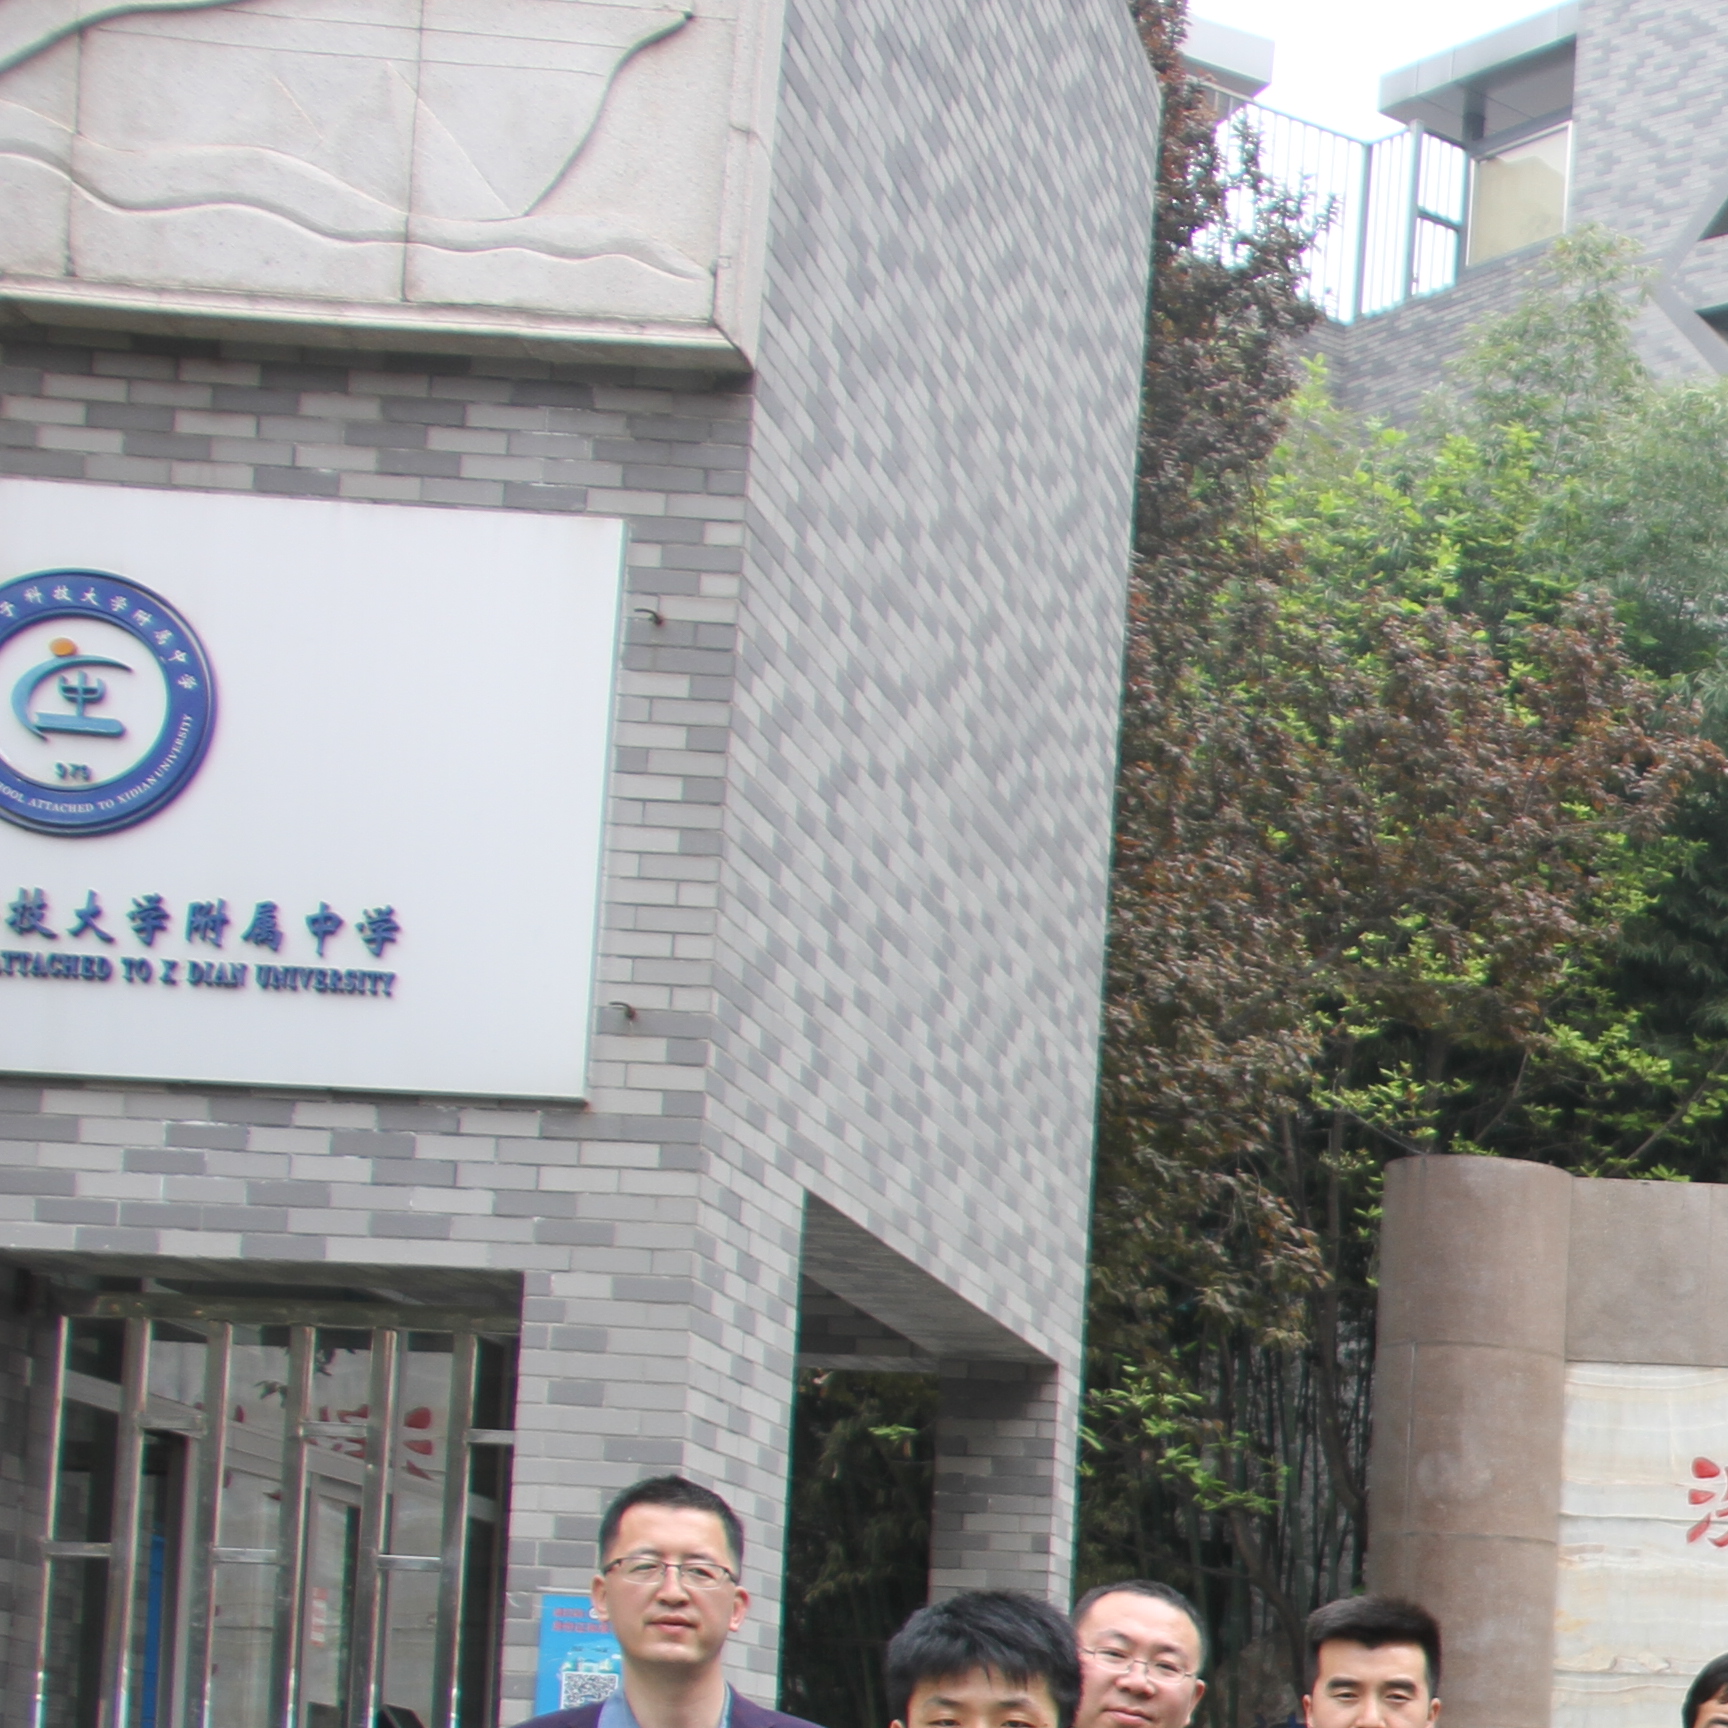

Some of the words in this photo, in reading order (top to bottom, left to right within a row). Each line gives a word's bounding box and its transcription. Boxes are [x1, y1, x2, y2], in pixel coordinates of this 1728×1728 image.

[28, 798, 94, 814] ATTACHED
[97, 799, 116, 811] TO
[117, 774, 158, 805] XIDIAN
[155, 713, 194, 778] UNIVERSITY
[5, 886, 402, 959] 技大学附属中学
[0, 950, 114, 982] TTACHED
[121, 956, 154, 984] TO
[255, 963, 398, 997] UNIVERSITY
